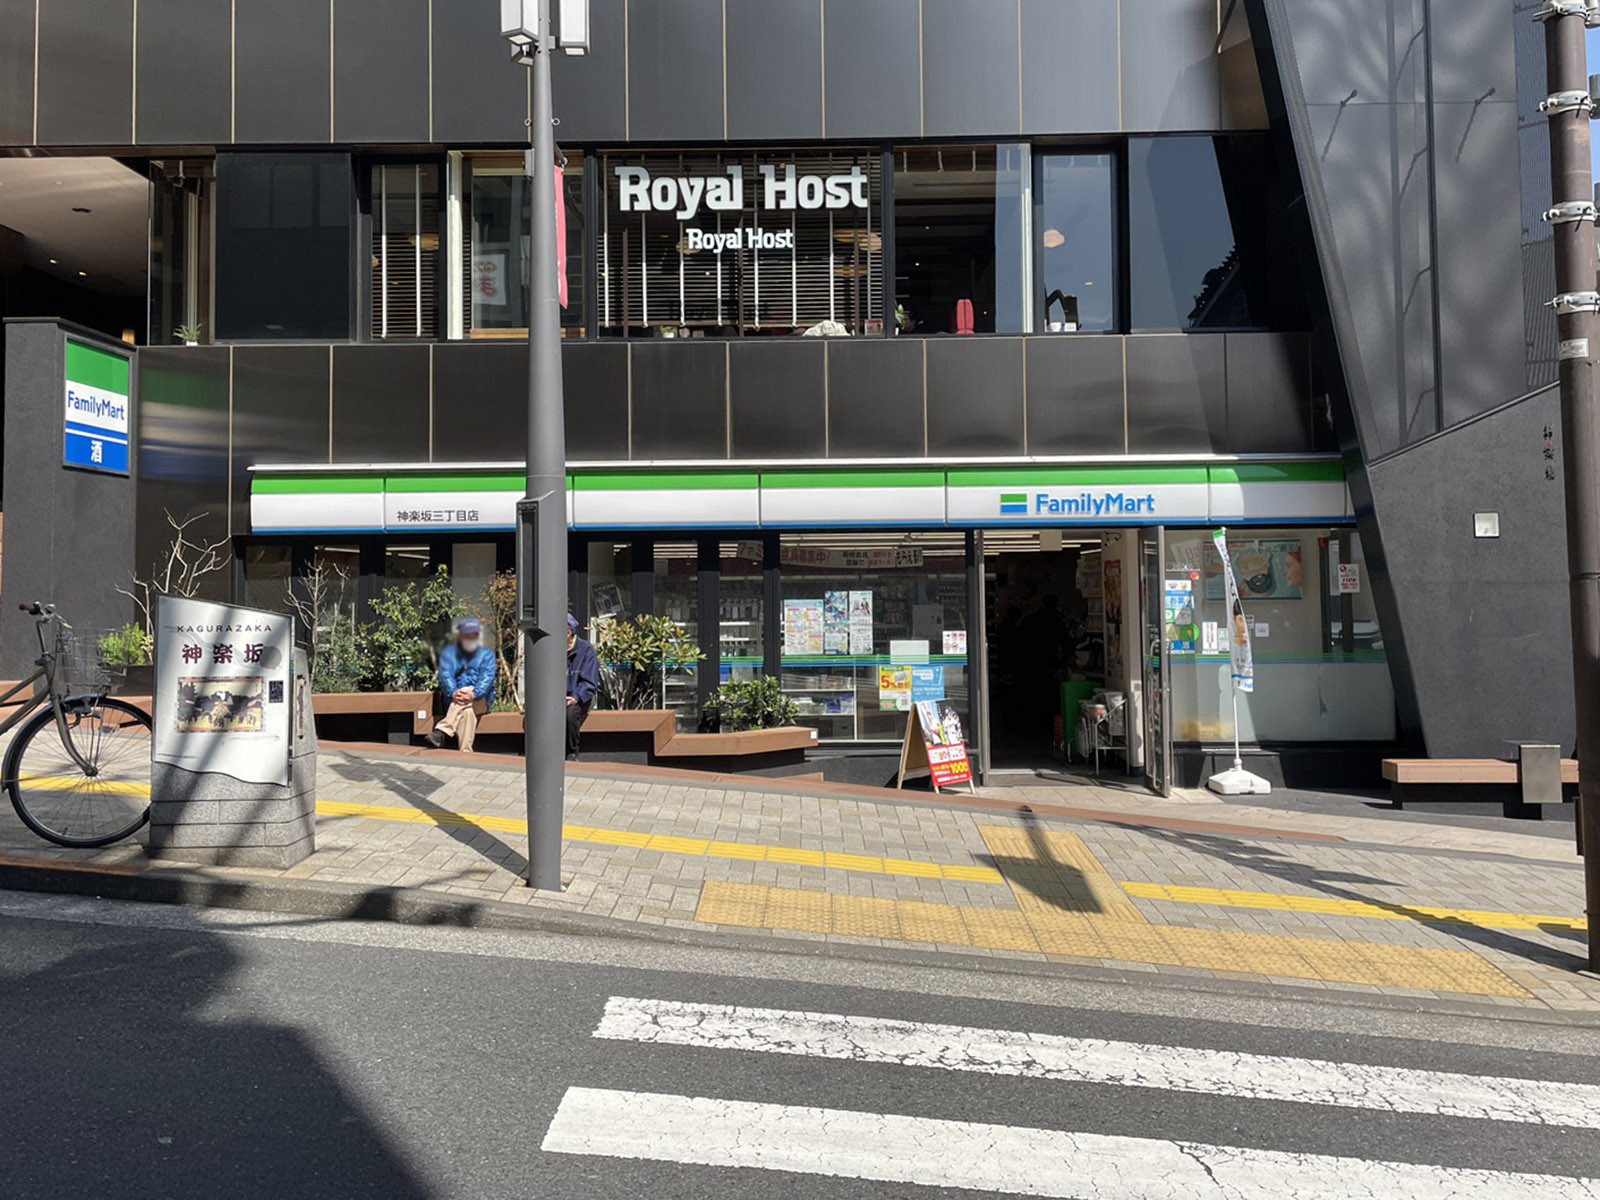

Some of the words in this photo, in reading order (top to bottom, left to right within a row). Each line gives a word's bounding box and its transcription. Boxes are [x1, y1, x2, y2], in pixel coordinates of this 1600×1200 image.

[614, 165, 743, 220] Royal
[759, 164, 869, 210] Host
[685, 228, 743, 253] Royal
[746, 227, 794, 249] Host
[67, 390, 125, 421] FamilyMart
[91, 440, 103, 463] 酒
[1035, 493, 1155, 515] FamilyMart
[397, 510, 479, 522] 神楽坂三丁目店
[177, 624, 272, 633] KAGURAZAKA
[182, 643, 264, 664] 神楽坂
